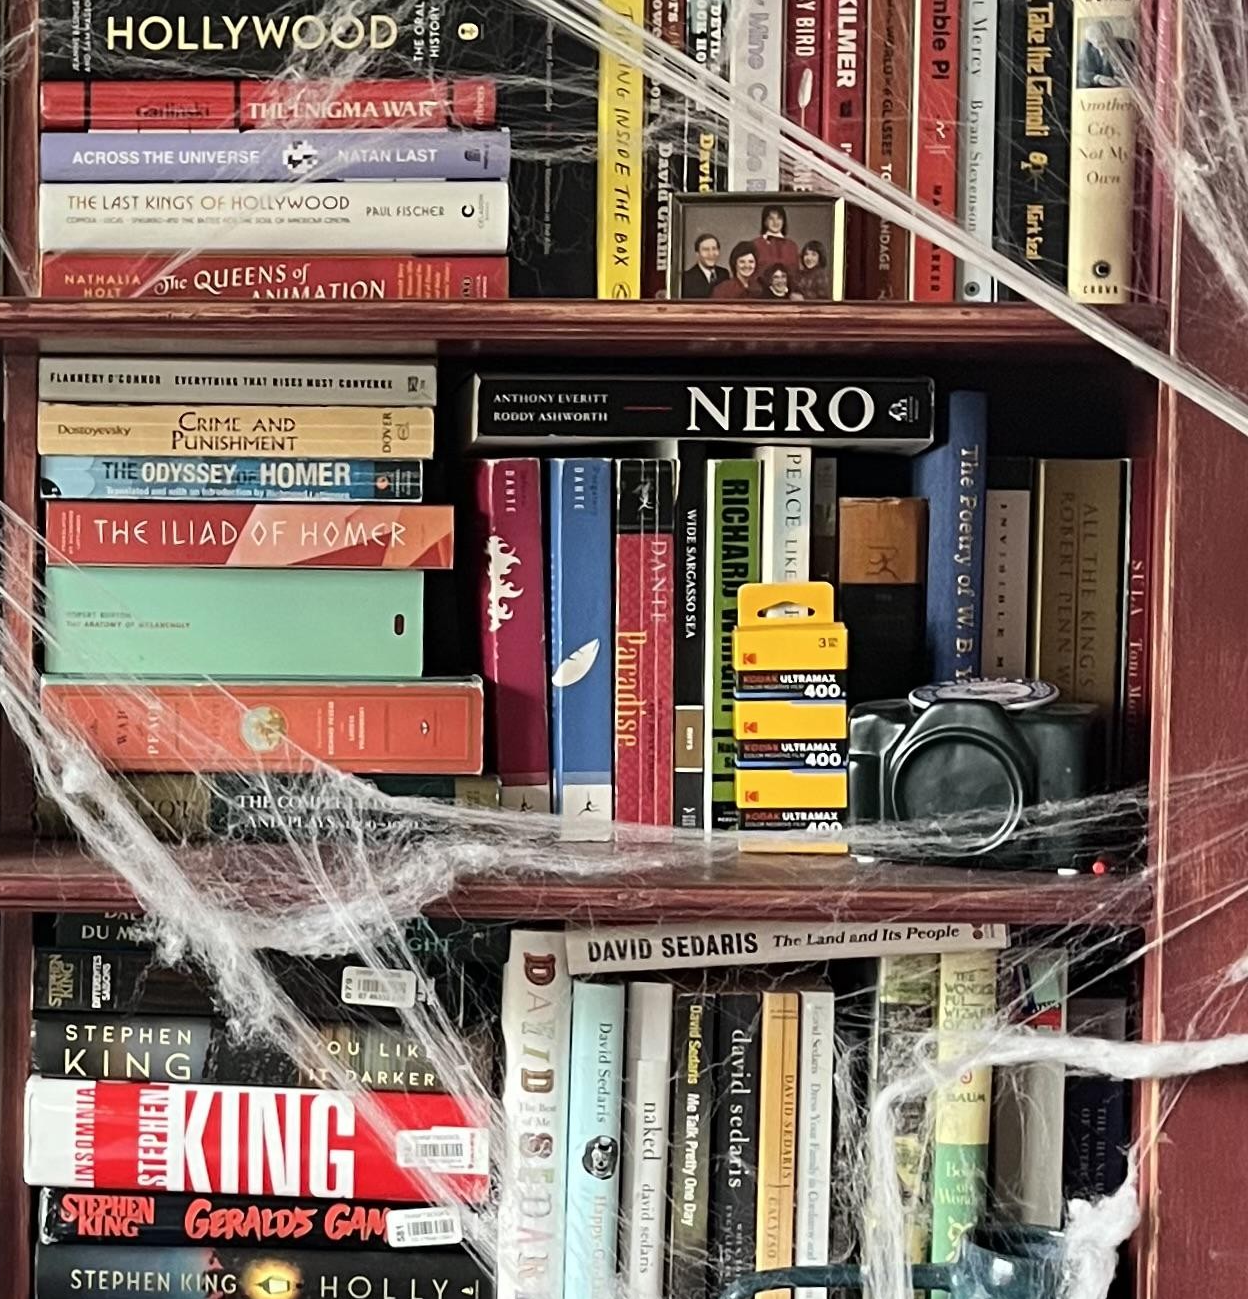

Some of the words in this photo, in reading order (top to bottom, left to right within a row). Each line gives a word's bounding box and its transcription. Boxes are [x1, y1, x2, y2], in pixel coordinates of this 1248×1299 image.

[413, 2, 425, 30] ORAL
[106, 16, 398, 50] HOLLYWOOD
[428, 7, 440, 58] HISTORY
[796, 18, 815, 57] BIRD
[414, 34, 425, 62] THE
[72, 152, 140, 165] ACROSS
[143, 152, 176, 165] THE
[179, 150, 260, 165] UNIVERSE
[338, 150, 393, 163] NATAN
[396, 149, 438, 163] LAST
[365, 206, 393, 217] PAUL
[396, 205, 445, 217] FISCHER
[193, 266, 288, 290] QUEENS
[292, 266, 308, 284] of
[494, 394, 553, 404] ANTHONY
[557, 394, 608, 404] EVERITT
[685, 387, 875, 432] NERO
[252, 417, 296, 432] AND
[494, 411, 534, 422] RODDY
[537, 411, 608, 422] ASHWORTH
[102, 462, 138, 480] THE
[141, 463, 235, 484] ODYSSEY
[260, 463, 351, 486] HOMER
[94, 519, 147, 545] THE
[161, 520, 238, 545] ILIAD
[251, 520, 288, 546] OF
[301, 522, 406, 548] HOMER
[781, 674, 836, 684] ULTRAMAX
[805, 684, 841, 697] 400
[588, 938, 652, 963] DAVID
[662, 932, 758, 959] SEDARIS
[806, 931, 845, 945] Land
[850, 930, 878, 942] and
[883, 928, 903, 941] Its
[907, 925, 959, 941] People
[74, 1087, 96, 1186] INSOMNIA
[138, 1085, 169, 1187] STEPHEN
[169, 1088, 356, 1199] KING
[70, 1269, 170, 1291] STEPHEN
[180, 1273, 237, 1294] KING
